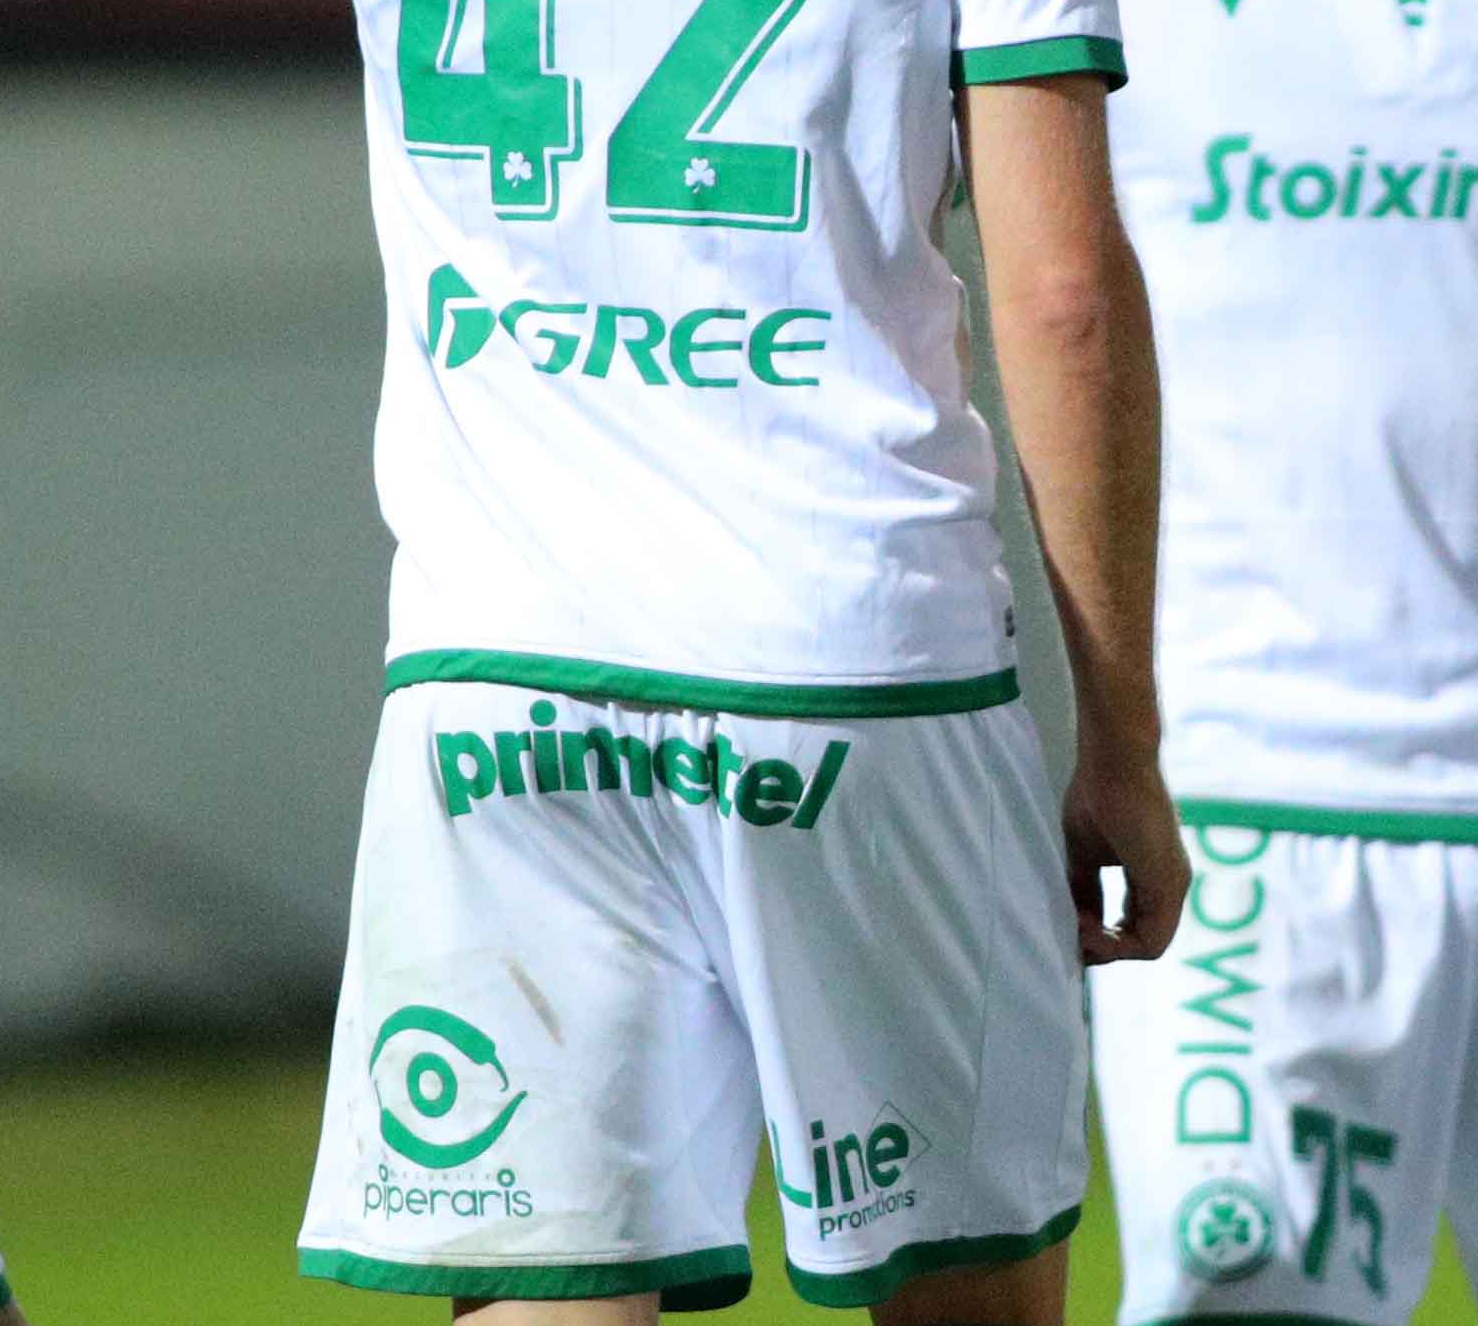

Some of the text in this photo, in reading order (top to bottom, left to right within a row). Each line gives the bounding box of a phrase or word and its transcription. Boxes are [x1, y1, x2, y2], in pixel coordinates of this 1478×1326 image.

[500, 302, 832, 388] GREE
[435, 699, 850, 829] primetel
[363, 1163, 534, 1222] piperaris
[770, 1118, 910, 1210] Line
[1291, 1102, 1397, 1300] 75
